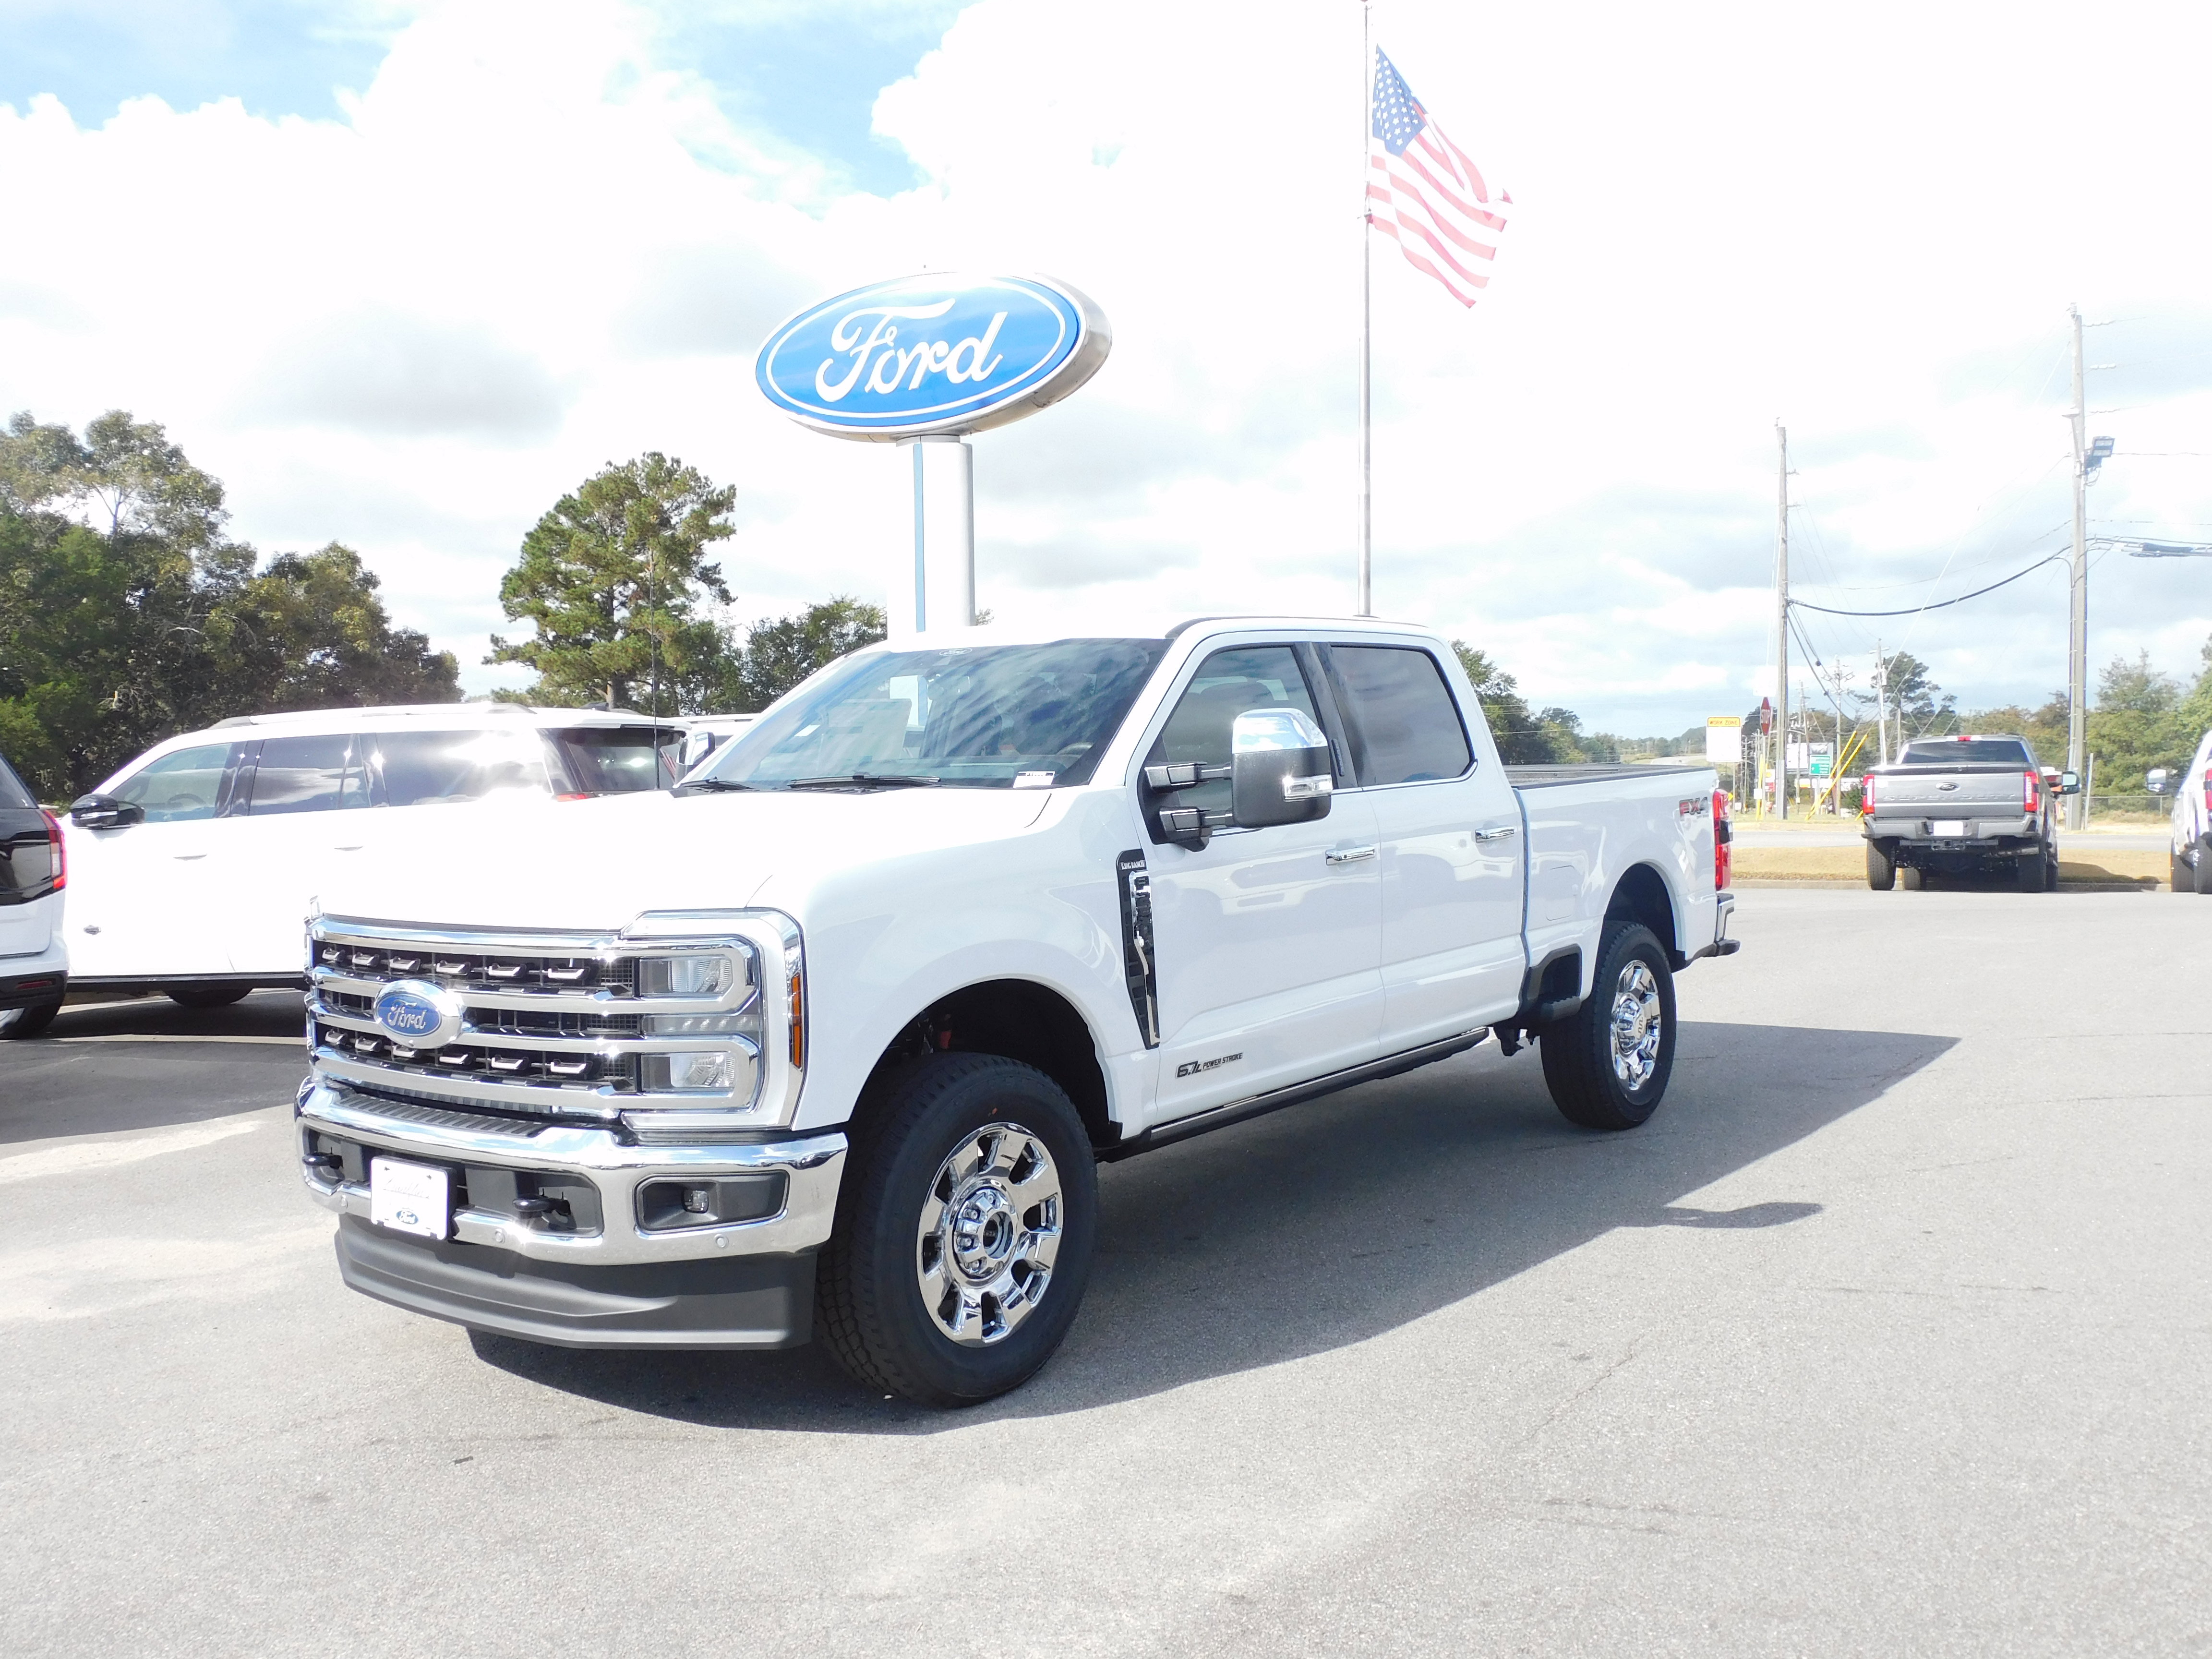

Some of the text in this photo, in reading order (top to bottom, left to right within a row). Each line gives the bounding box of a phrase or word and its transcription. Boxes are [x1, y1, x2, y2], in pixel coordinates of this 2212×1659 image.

[816, 297, 1007, 402] Ford
[387, 999, 427, 1029] Ford
[1177, 1060, 1202, 1078] 6.7L
[1202, 1058, 1221, 1069] POWER
[1222, 1052, 1243, 1064] STROKE
